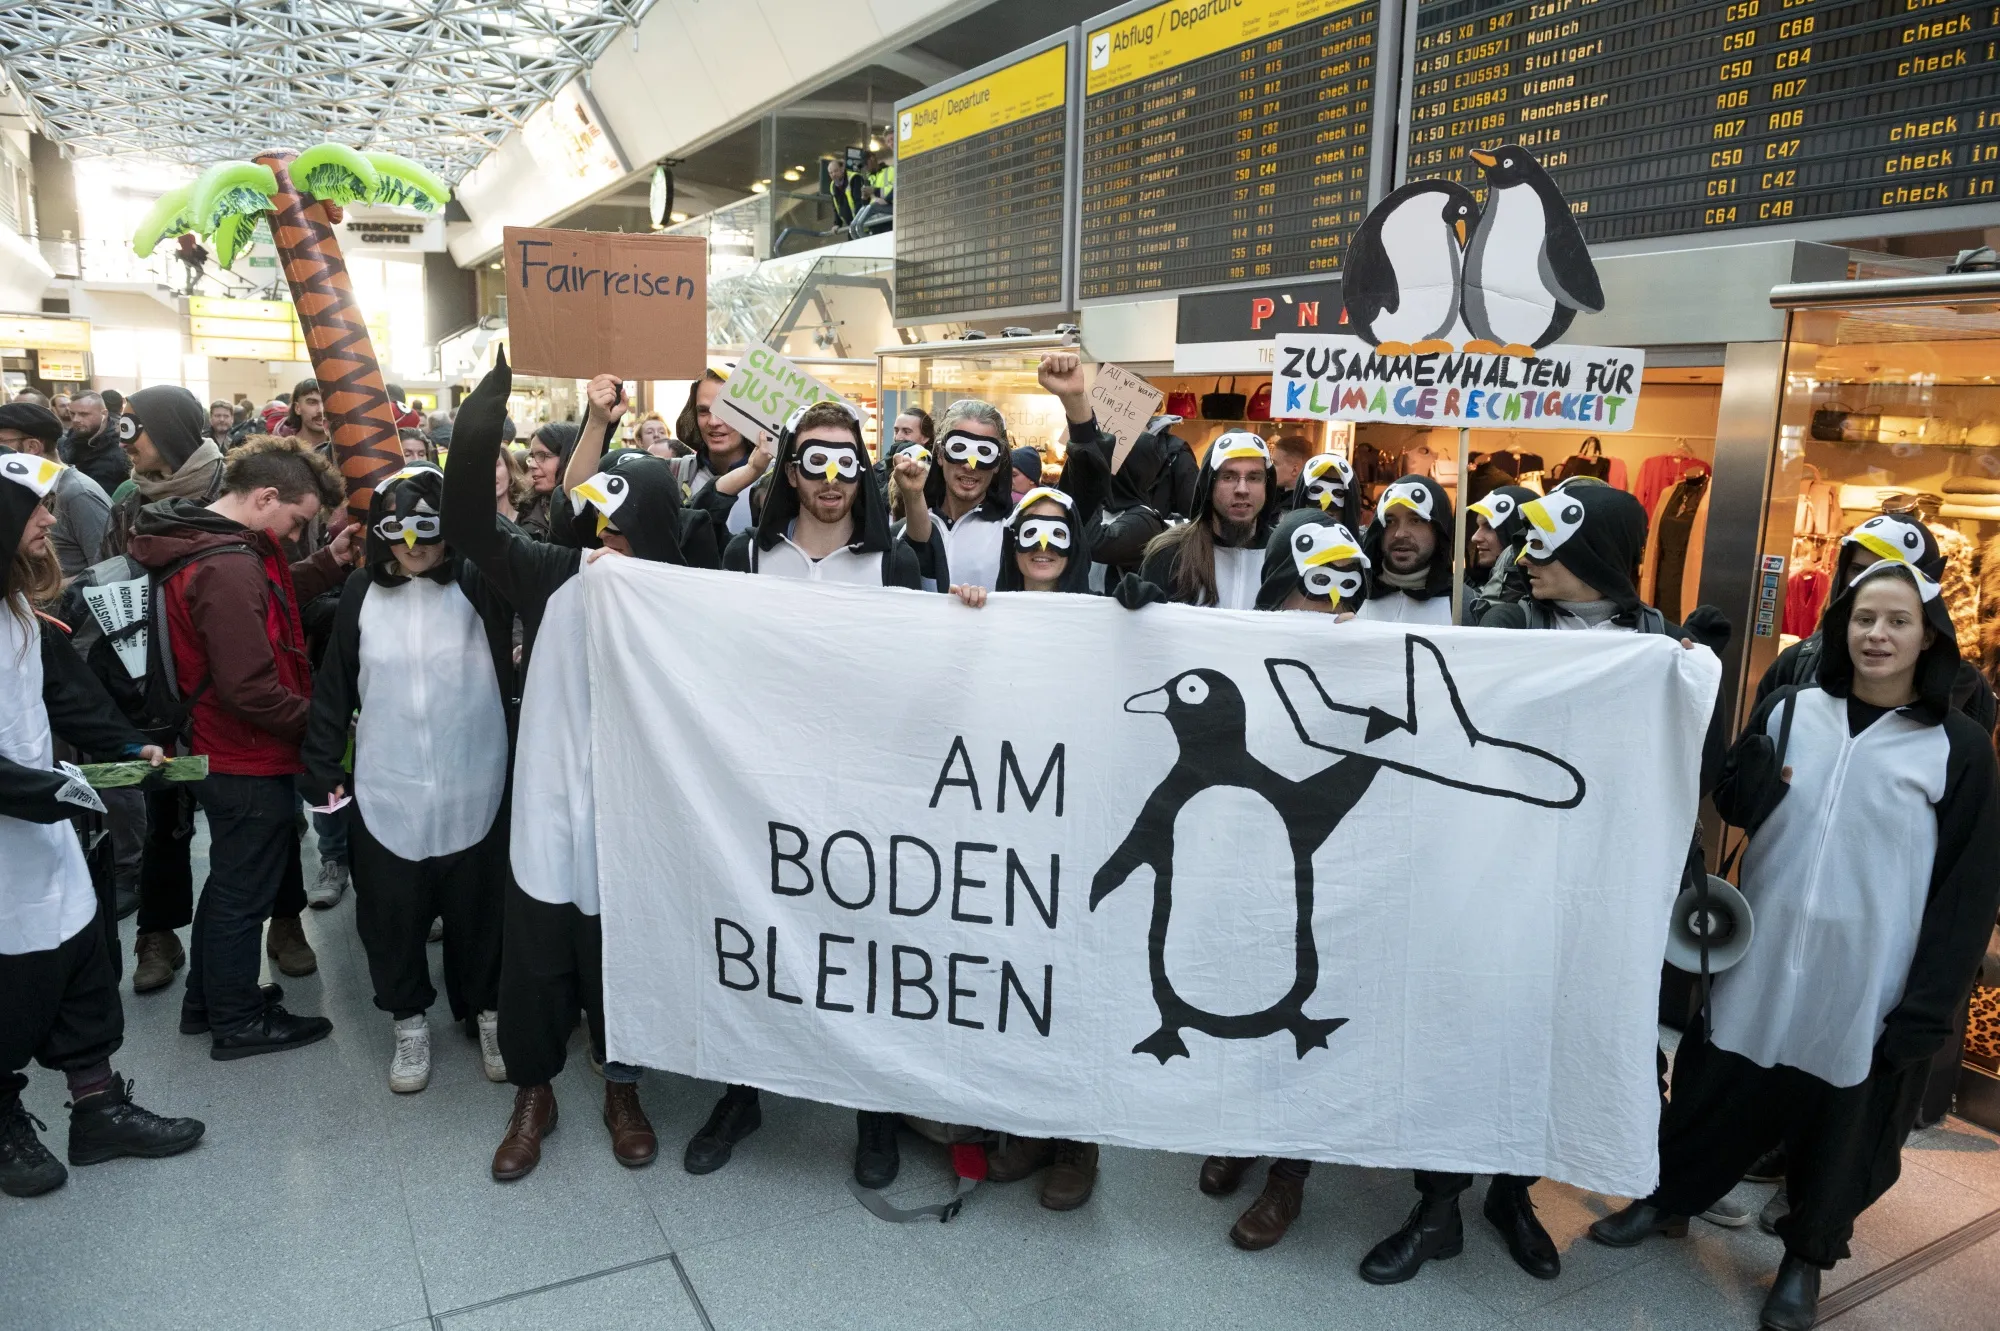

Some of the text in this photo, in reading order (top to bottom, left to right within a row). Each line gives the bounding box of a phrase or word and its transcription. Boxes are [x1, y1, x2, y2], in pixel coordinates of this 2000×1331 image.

[1112, 0, 1243, 53] Abflug / Departure
[1322, 16, 1353, 36] check
[1360, 11, 1373, 24] in
[1417, 30, 1452, 51] 14:45
[1489, 12, 1514, 31] 947
[1529, 0, 1573, 20] Izmir
[1321, 34, 1372, 58] boarding
[1413, 0, 1759, 98] 14:50 EJU5593 Stuttgart C50
[1415, 20, 1579, 75] 14:50 EJU5571 Munich
[1320, 60, 1350, 80] check
[1358, 56, 1370, 68] in
[1410, 127, 1445, 145] 14:50
[1521, 93, 1609, 122] Manchester
[1720, 60, 1752, 81] C50
[1776, 47, 1811, 69] C84
[1902, 14, 1971, 43] check
[1411, 102, 1446, 121] 14:50
[1523, 74, 1575, 97] Vienna
[1723, 30, 1756, 52] C50
[1780, 16, 1815, 39] C68
[914, 108, 938, 127] Abflug
[947, 88, 990, 116] Departure
[1319, 82, 1349, 101] check
[1356, 79, 1369, 91] in
[1408, 149, 1443, 168] 14:55
[1519, 128, 1561, 147] Malta
[1772, 78, 1807, 100] A07
[1898, 48, 1967, 76] check
[1317, 104, 1348, 123] check
[1355, 101, 1367, 113] in
[1713, 120, 1745, 139] A07
[1316, 126, 1346, 144] check
[1354, 123, 1366, 135] in
[1711, 148, 1742, 168] C50
[1766, 139, 1800, 159] C47
[1889, 115, 1957, 141] check
[1977, 110, 2000, 129] in
[1315, 148, 1345, 165] check
[1352, 145, 1365, 157] in
[1707, 144, 1998, 196] C61 C42 check in
[1314, 170, 1344, 186] check
[1351, 167, 1363, 179] in
[1313, 191, 1342, 207] check
[1350, 189, 1362, 201] in
[1705, 178, 1994, 225] C64 C48 check in
[1311, 212, 1341, 228] check
[1349, 211, 1361, 223] in
[1310, 233, 1340, 249] check
[517, 240, 695, 300] Fairreisen
[1309, 255, 1339, 270] check
[1105, 367, 1159, 400] All we want
[1280, 346, 1635, 395] ZUSAMMENHALTEN FÜR
[1091, 386, 1136, 421] Climate
[1285, 380, 1627, 426] KLIMAGERECHTIGKEIT
[928, 735, 1065, 817] AM
[768, 820, 1060, 930] BODEN
[714, 917, 1053, 1037] BLEIBEN
